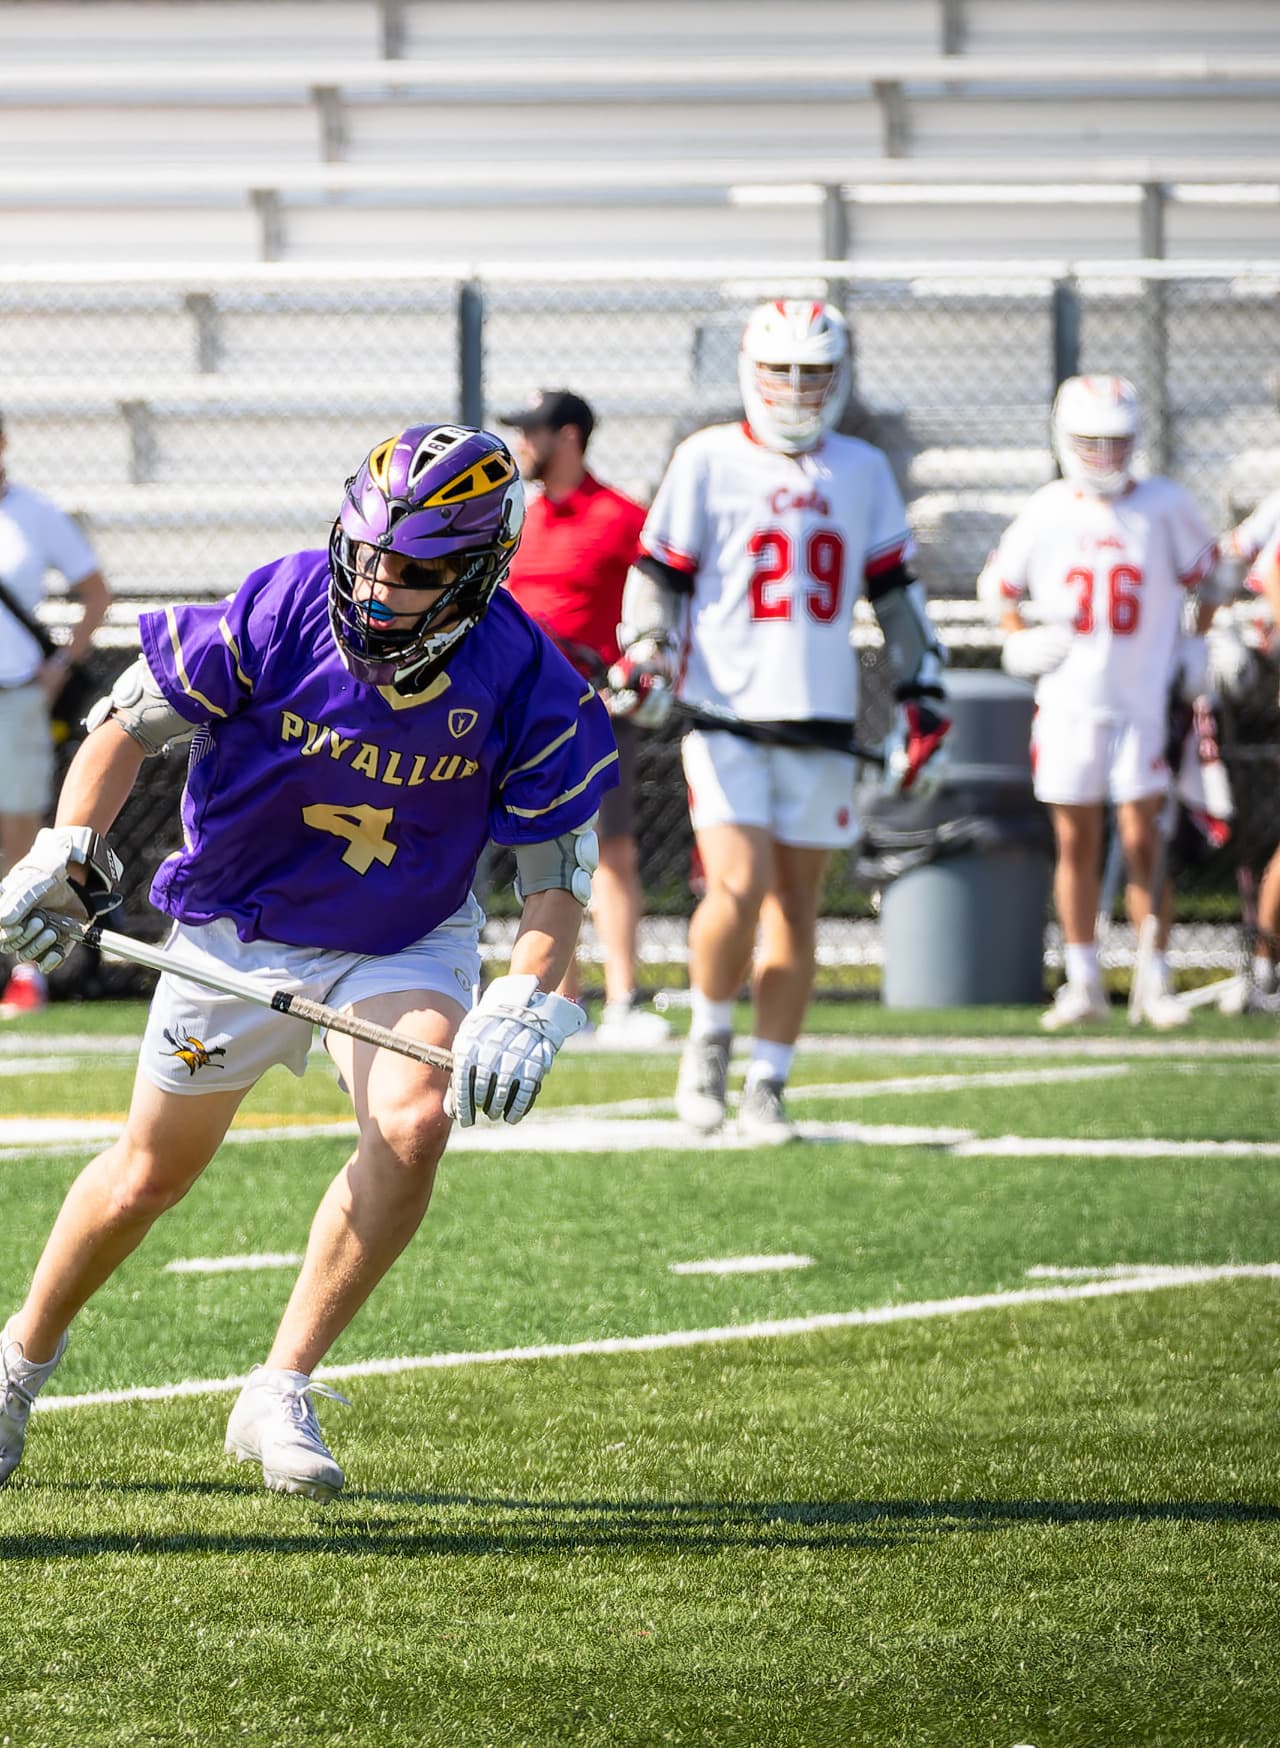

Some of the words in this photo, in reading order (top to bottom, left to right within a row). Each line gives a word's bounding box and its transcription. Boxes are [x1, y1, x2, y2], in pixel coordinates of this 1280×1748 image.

[747, 526, 845, 624] 29
[1065, 564, 1144, 634] 36
[280, 710, 479, 787] PUYALLUP
[301, 803, 398, 876] 4
